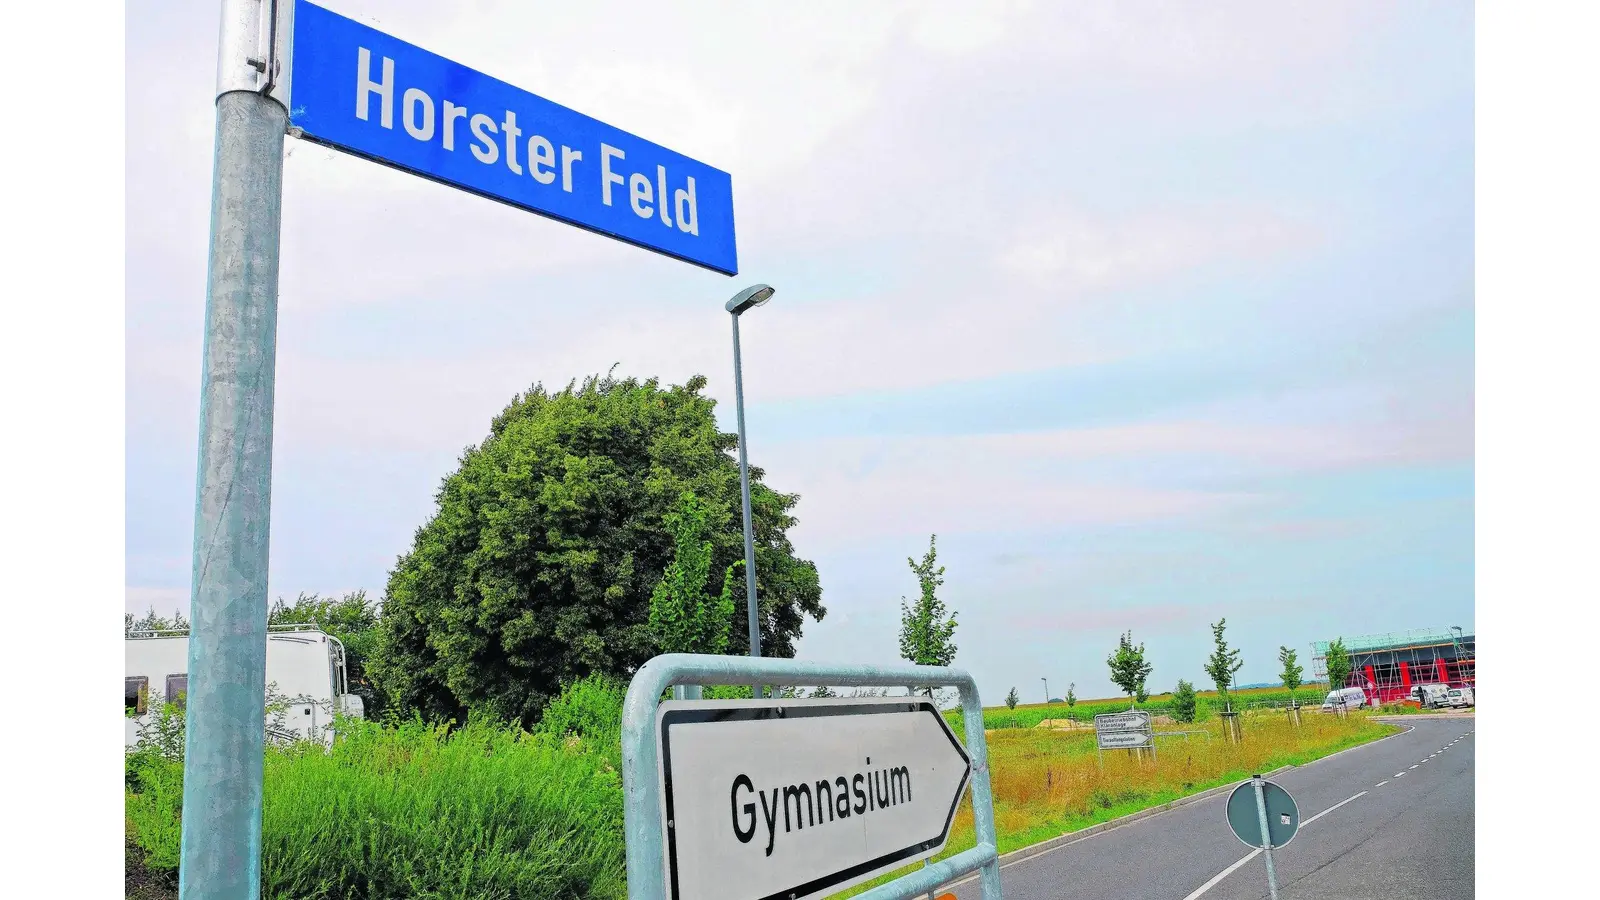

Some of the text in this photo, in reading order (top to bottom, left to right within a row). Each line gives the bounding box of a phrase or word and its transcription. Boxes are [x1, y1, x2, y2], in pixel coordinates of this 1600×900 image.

[355, 46, 699, 237] Horster Feld
[731, 757, 912, 857] Gymnasium
